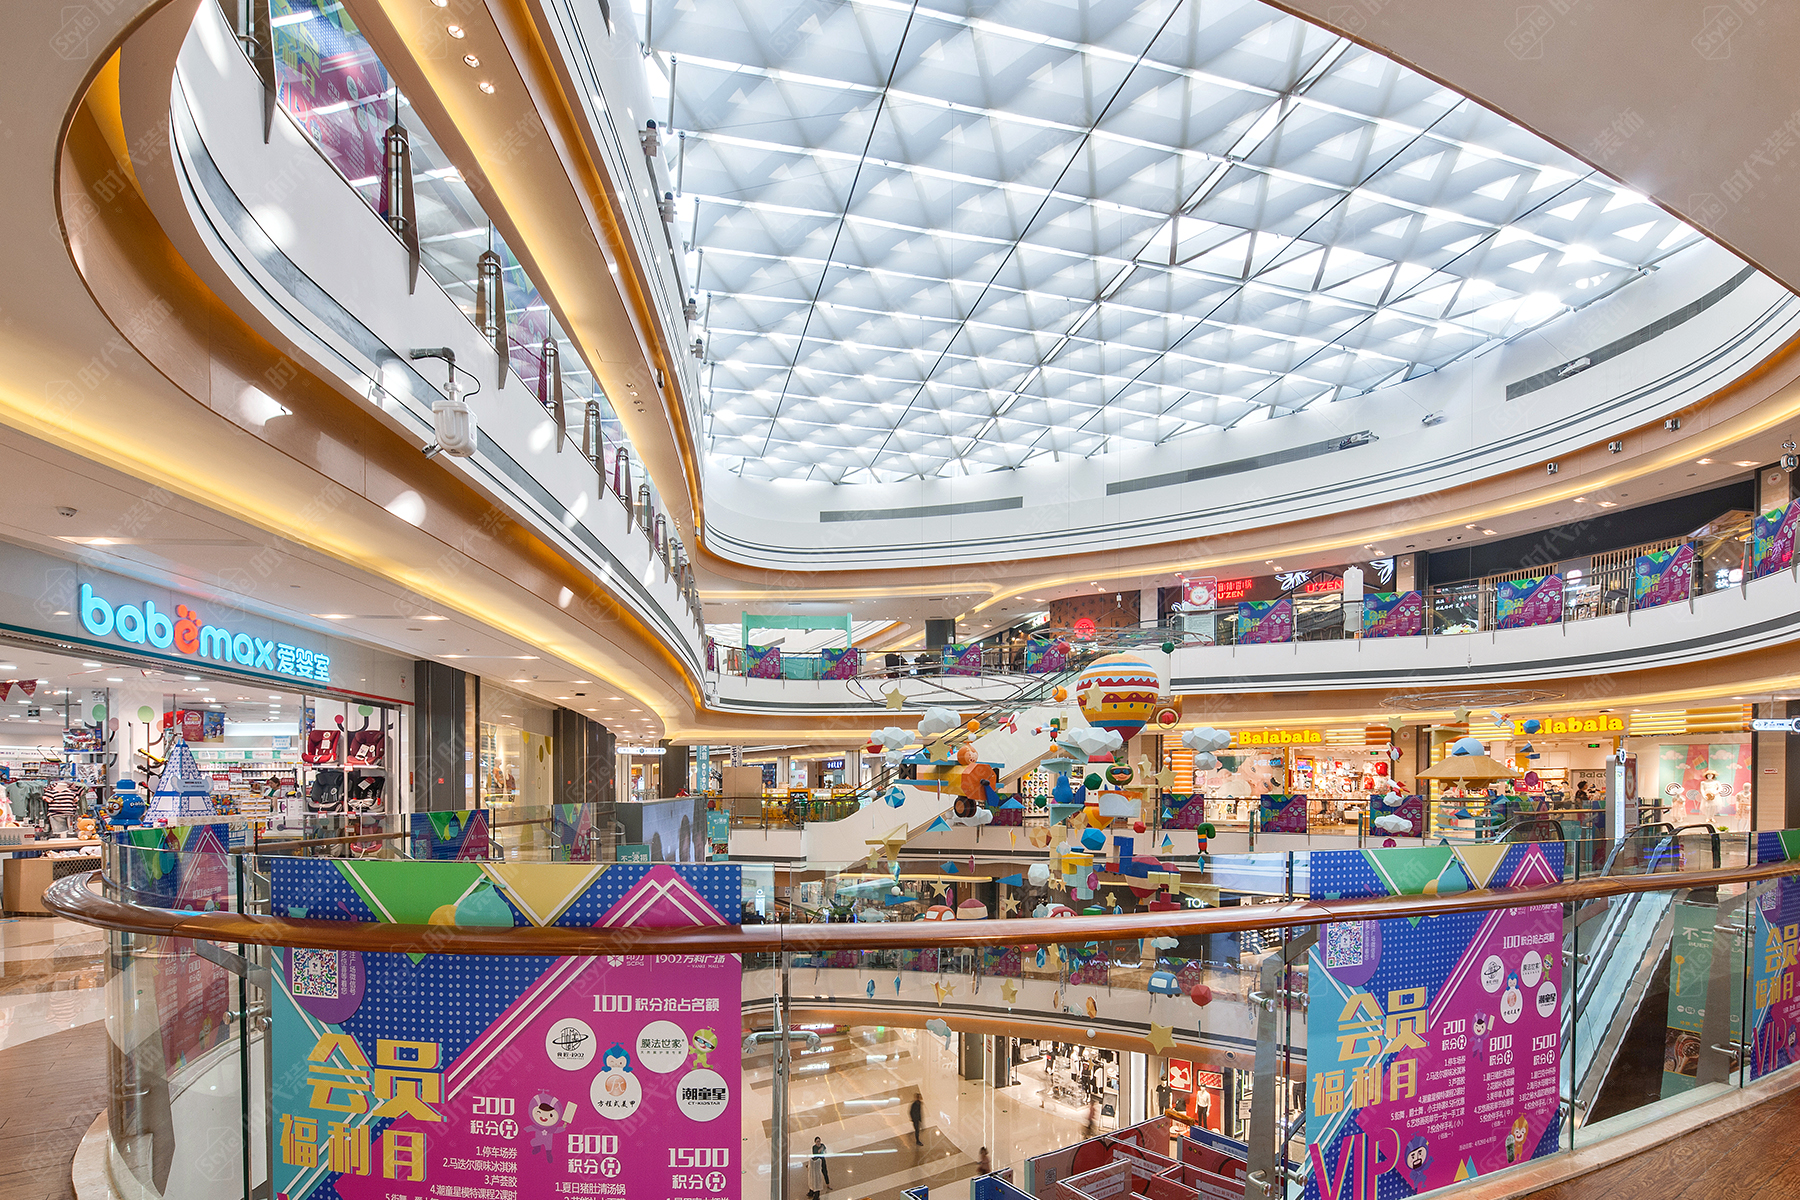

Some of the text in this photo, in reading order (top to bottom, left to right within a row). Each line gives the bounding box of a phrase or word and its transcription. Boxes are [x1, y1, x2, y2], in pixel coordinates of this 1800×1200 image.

[80, 583, 274, 669] babemax
[276, 641, 331, 682] 爱婴室
[1513, 715, 1624, 735] Blabala
[1238, 729, 1321, 745] Balabala
[1503, 935, 1520, 949] 100
[1764, 923, 1798, 973] 会员
[1755, 971, 1794, 1010] 福利月
[593, 995, 720, 1013] 100 积分抢占名额
[1336, 986, 1430, 1062] 会员
[1443, 1019, 1466, 1035] 200
[641, 1039, 682, 1049] 膜法世家
[1489, 1034, 1512, 1052] 800
[1532, 1033, 1557, 1051] 1500
[1753, 1018, 1787, 1076] VIP
[307, 1033, 446, 1122] 会员
[1312, 1058, 1418, 1117] 福利月
[682, 1087, 726, 1101] 潮童星
[472, 1097, 515, 1115] 200
[280, 1113, 427, 1182] 福利月
[567, 1134, 619, 1154] 800
[668, 1148, 730, 1168] 1500
